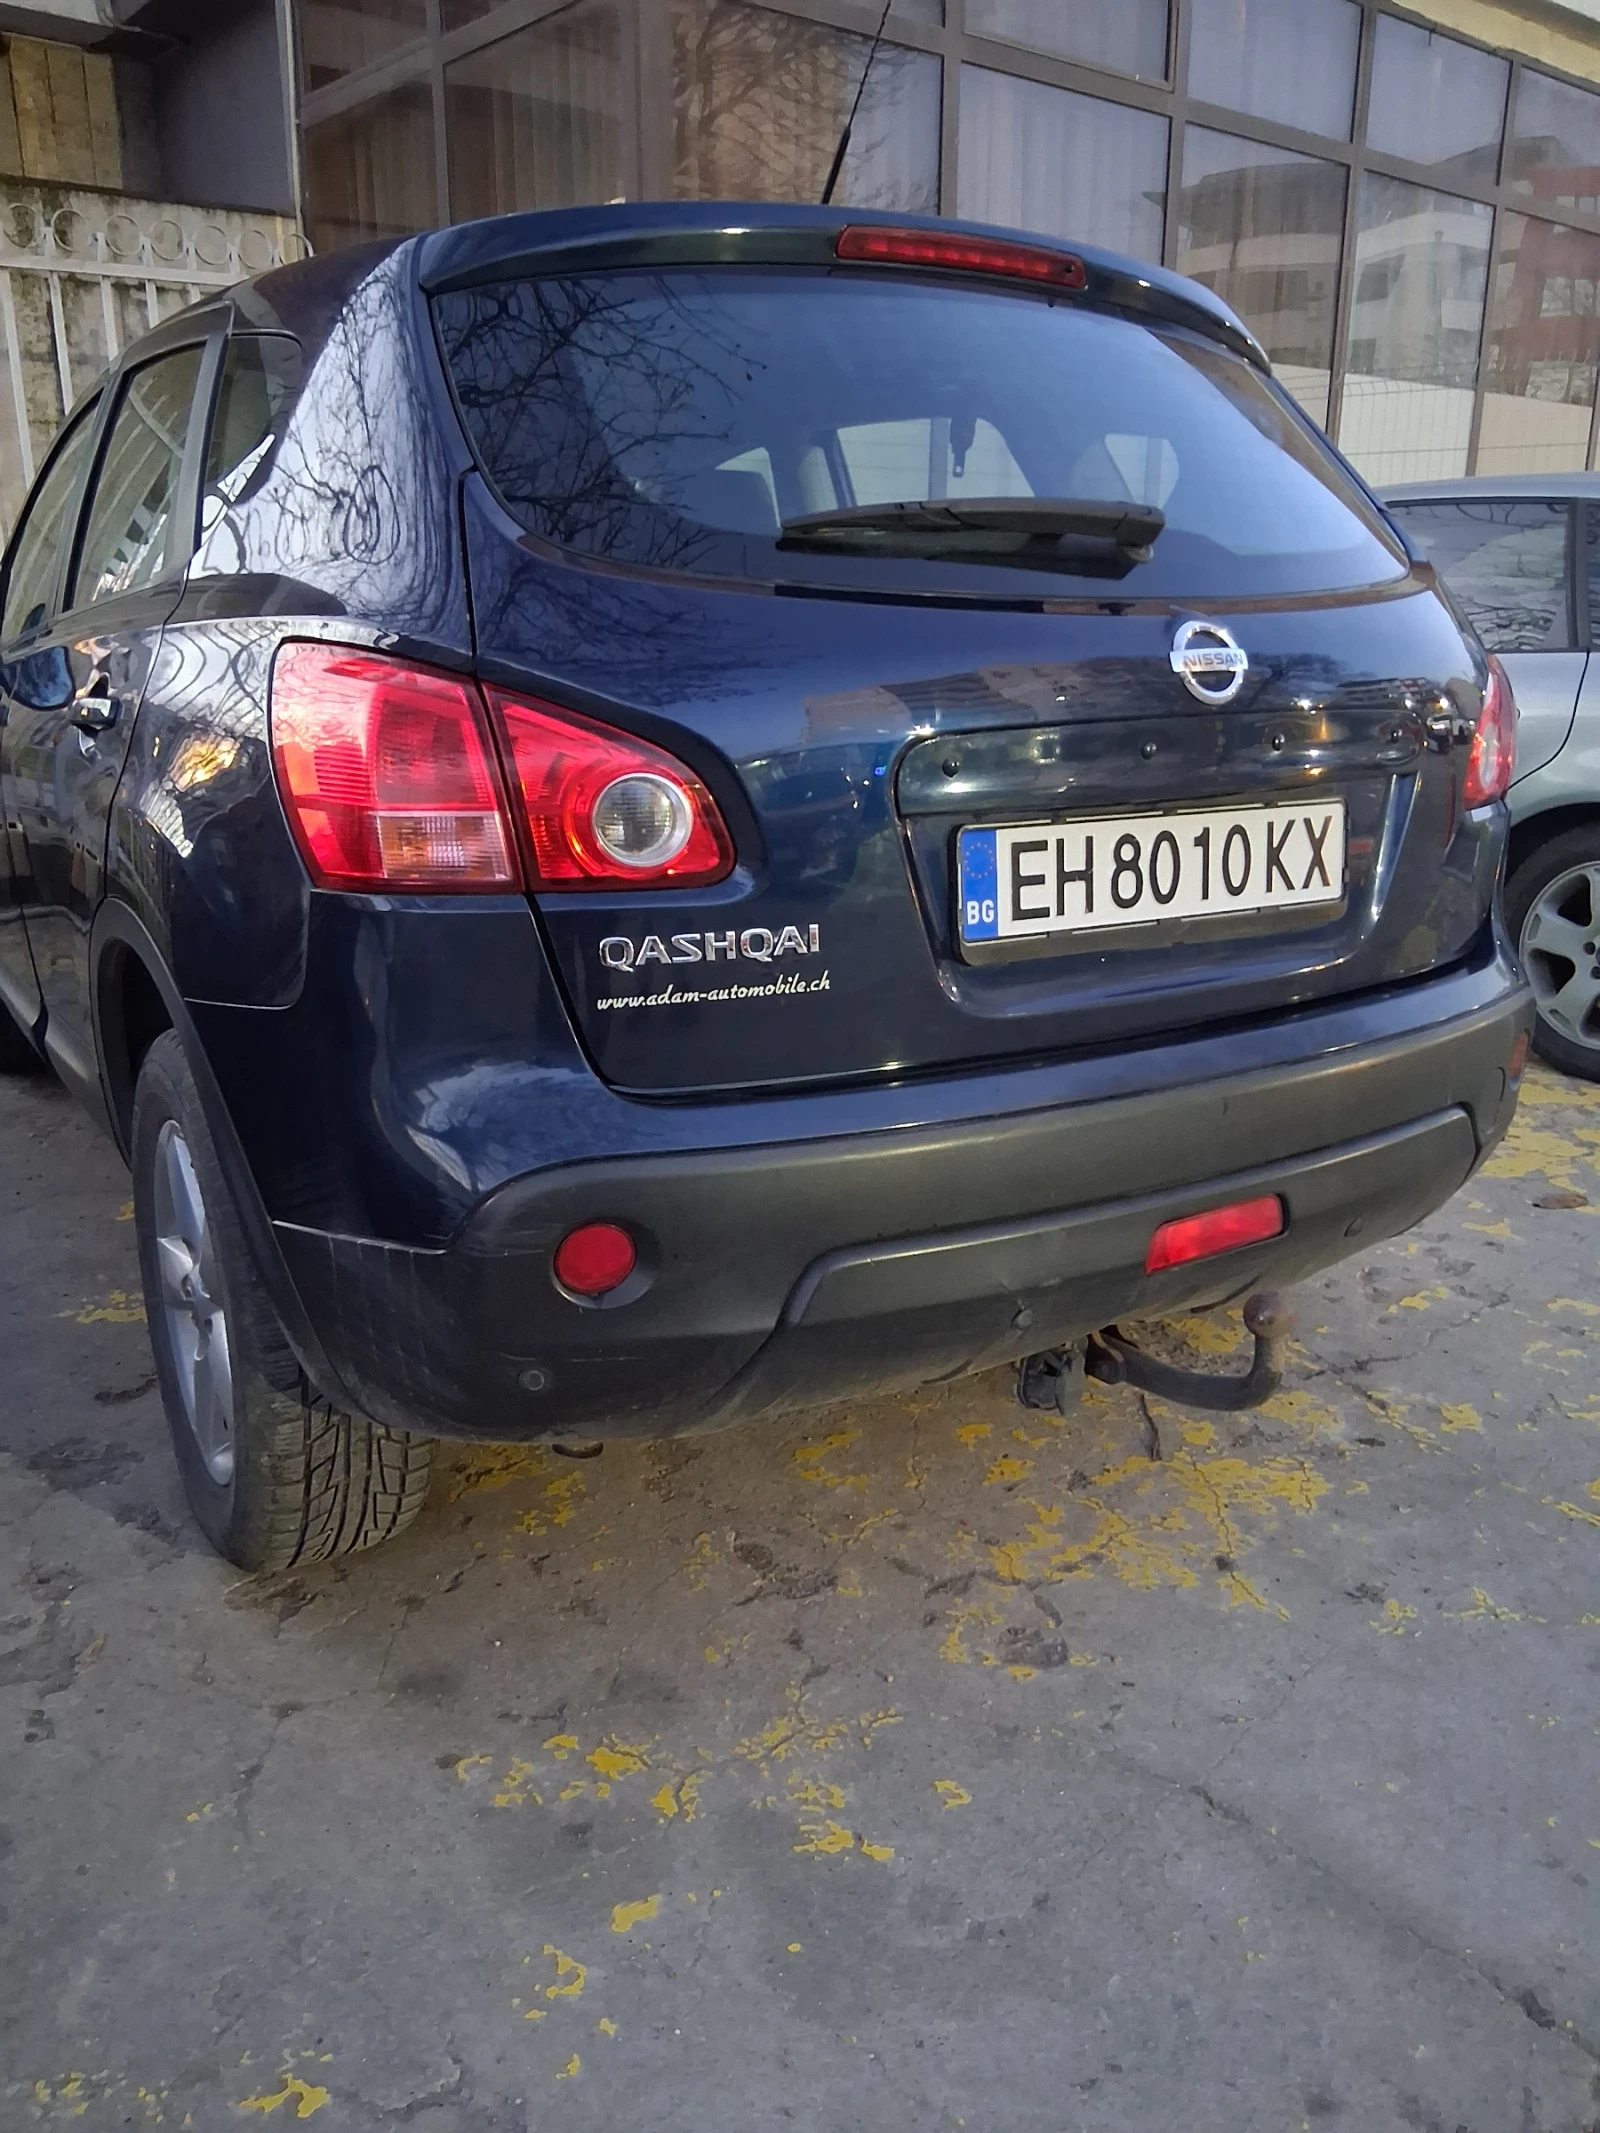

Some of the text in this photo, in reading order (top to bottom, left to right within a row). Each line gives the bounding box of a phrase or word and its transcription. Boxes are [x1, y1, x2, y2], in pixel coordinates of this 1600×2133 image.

[1183, 652, 1243, 667] NISSAN
[966, 899, 995, 925] BG
[599, 923, 820, 973] QASHQAI
[596, 969, 831, 1011] www.adam-automobile.ch
